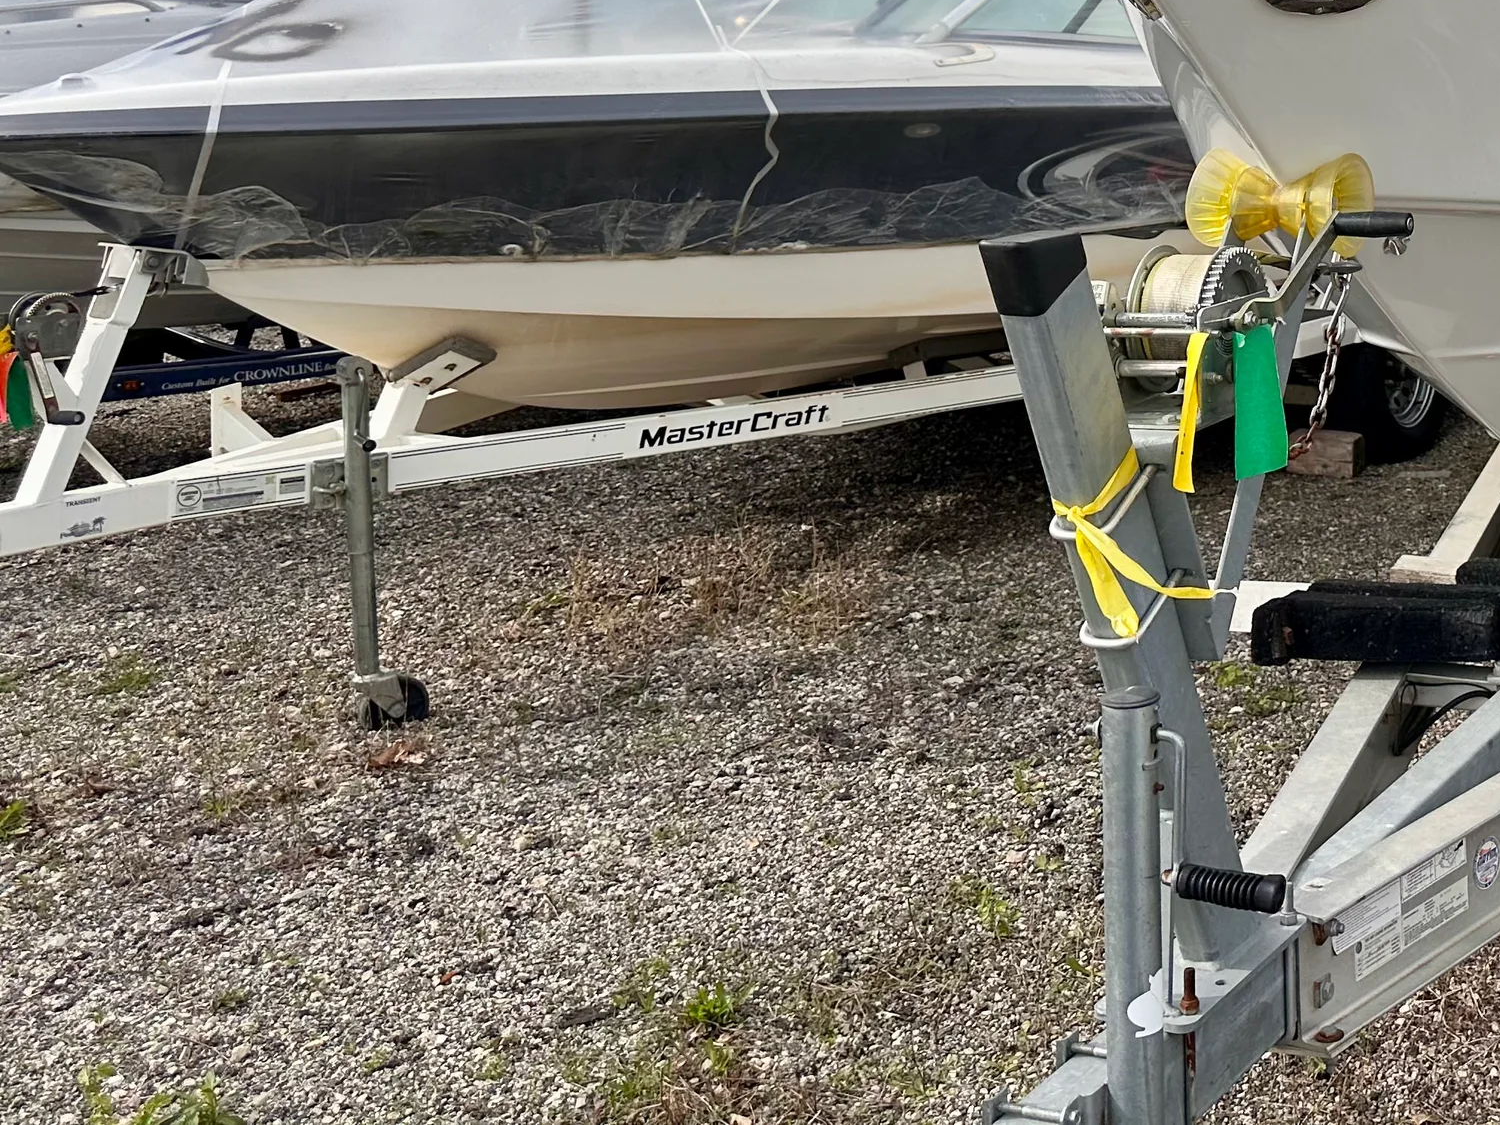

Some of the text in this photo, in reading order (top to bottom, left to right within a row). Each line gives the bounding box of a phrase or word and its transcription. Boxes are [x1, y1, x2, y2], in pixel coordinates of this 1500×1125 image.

[161, 380, 194, 391] Custom
[196, 378, 217, 387] Built
[218, 377, 231, 386] for
[233, 361, 323, 382] CROWNLINE
[638, 403, 829, 449] MasterCraft
